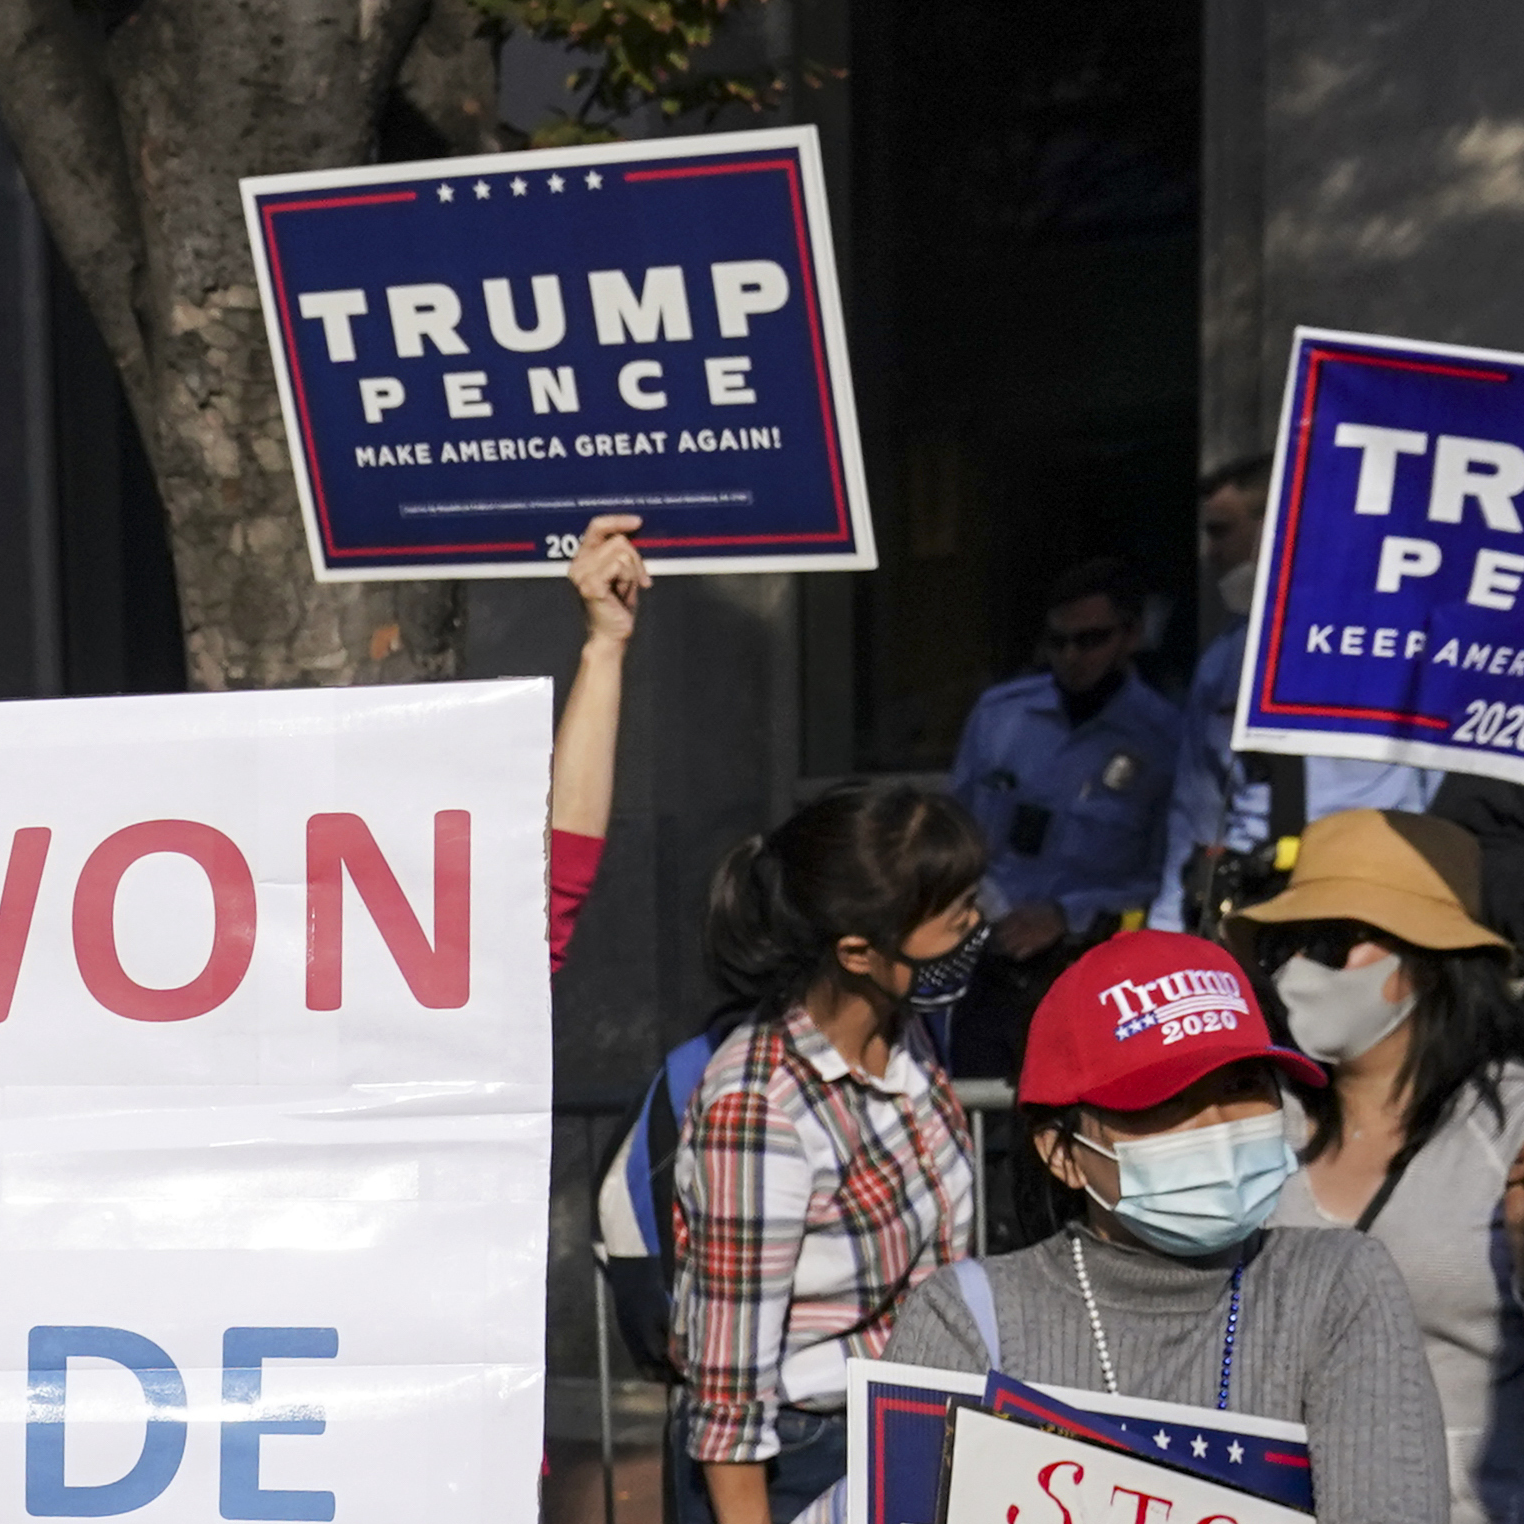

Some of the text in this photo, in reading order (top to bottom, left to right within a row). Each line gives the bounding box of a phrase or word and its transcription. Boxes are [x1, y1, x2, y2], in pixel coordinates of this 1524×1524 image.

[299, 259, 790, 363] TRUMP
[359, 357, 757, 423] PENCE
[355, 426, 783, 468] MAKE AMERICA GREAT AGAIN!
[545, 533, 586, 559] 20
[1306, 624, 1427, 659] KEEP
[1098, 968, 1241, 1026] Trump
[1160, 1010, 1238, 1046] 2020
